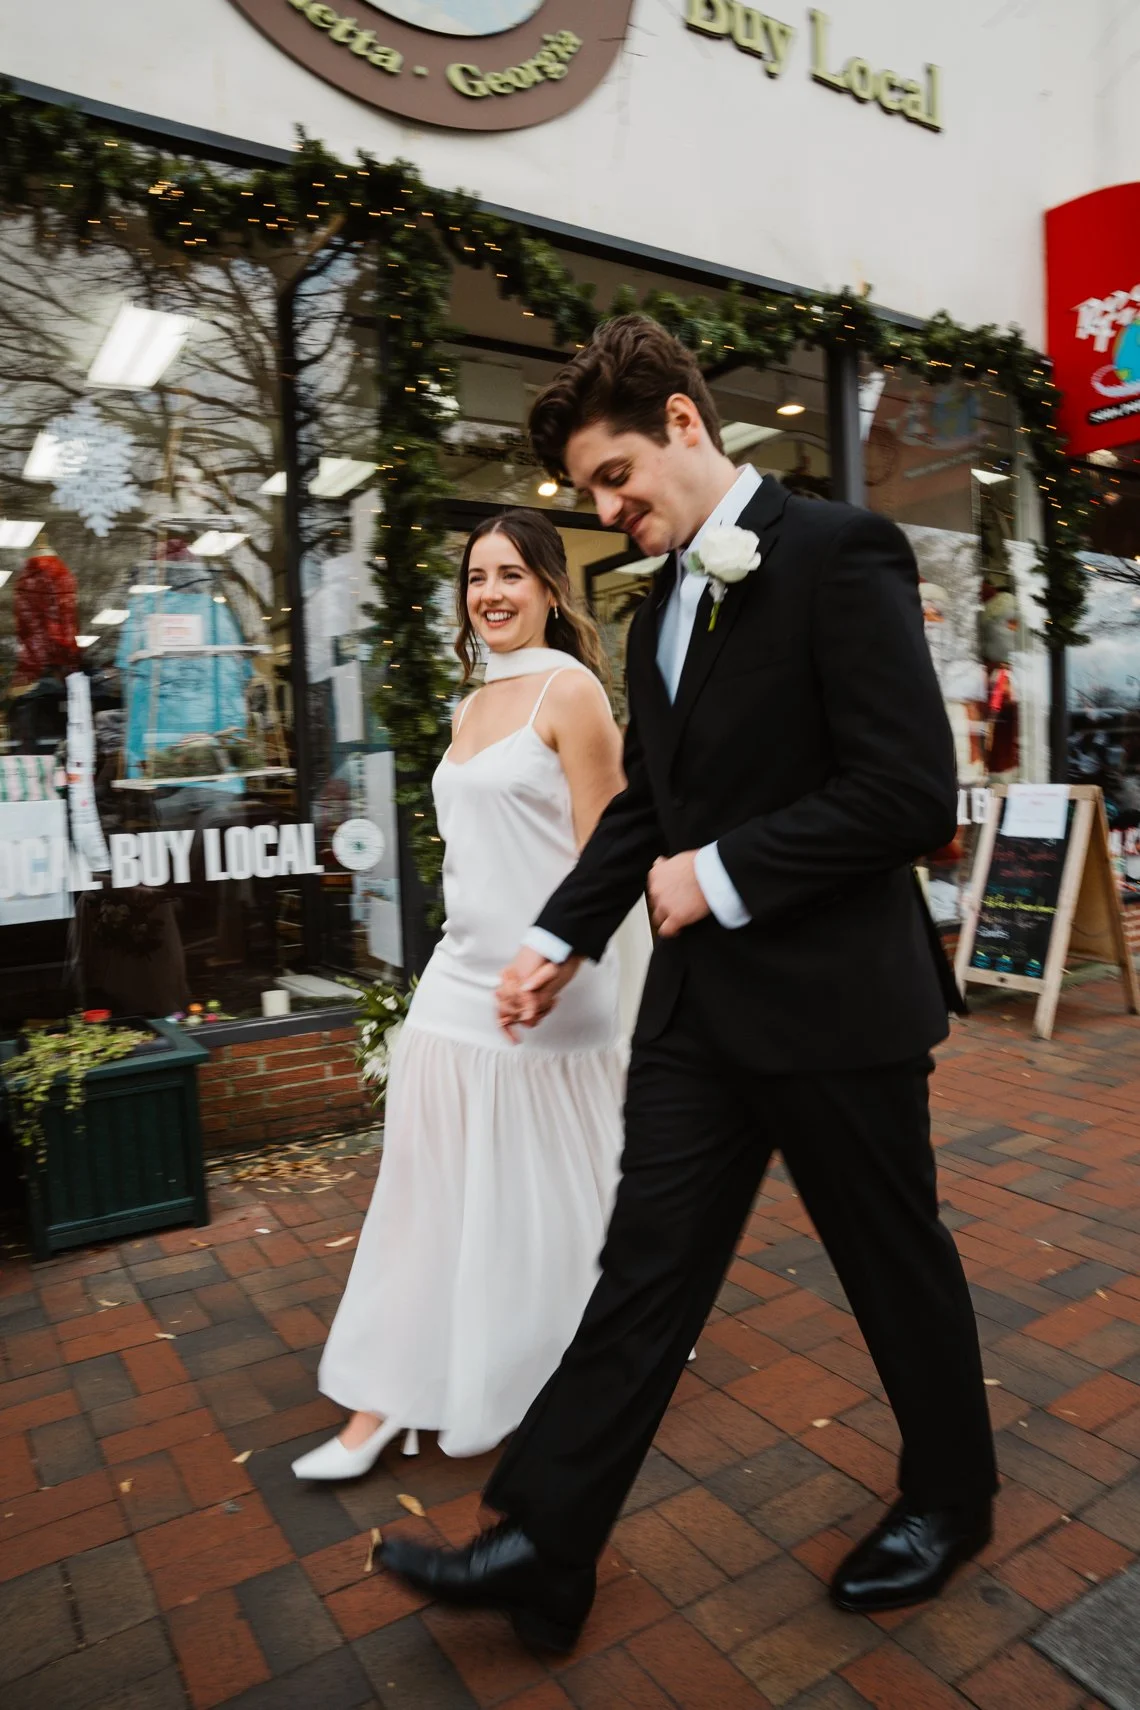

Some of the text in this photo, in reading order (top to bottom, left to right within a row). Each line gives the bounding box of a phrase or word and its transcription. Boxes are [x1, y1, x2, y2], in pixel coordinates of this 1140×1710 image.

[445, 29, 583, 97] Georgia
[808, 8, 943, 131] Local
[109, 829, 195, 889] BUY
[203, 823, 325, 881] LOCAL
